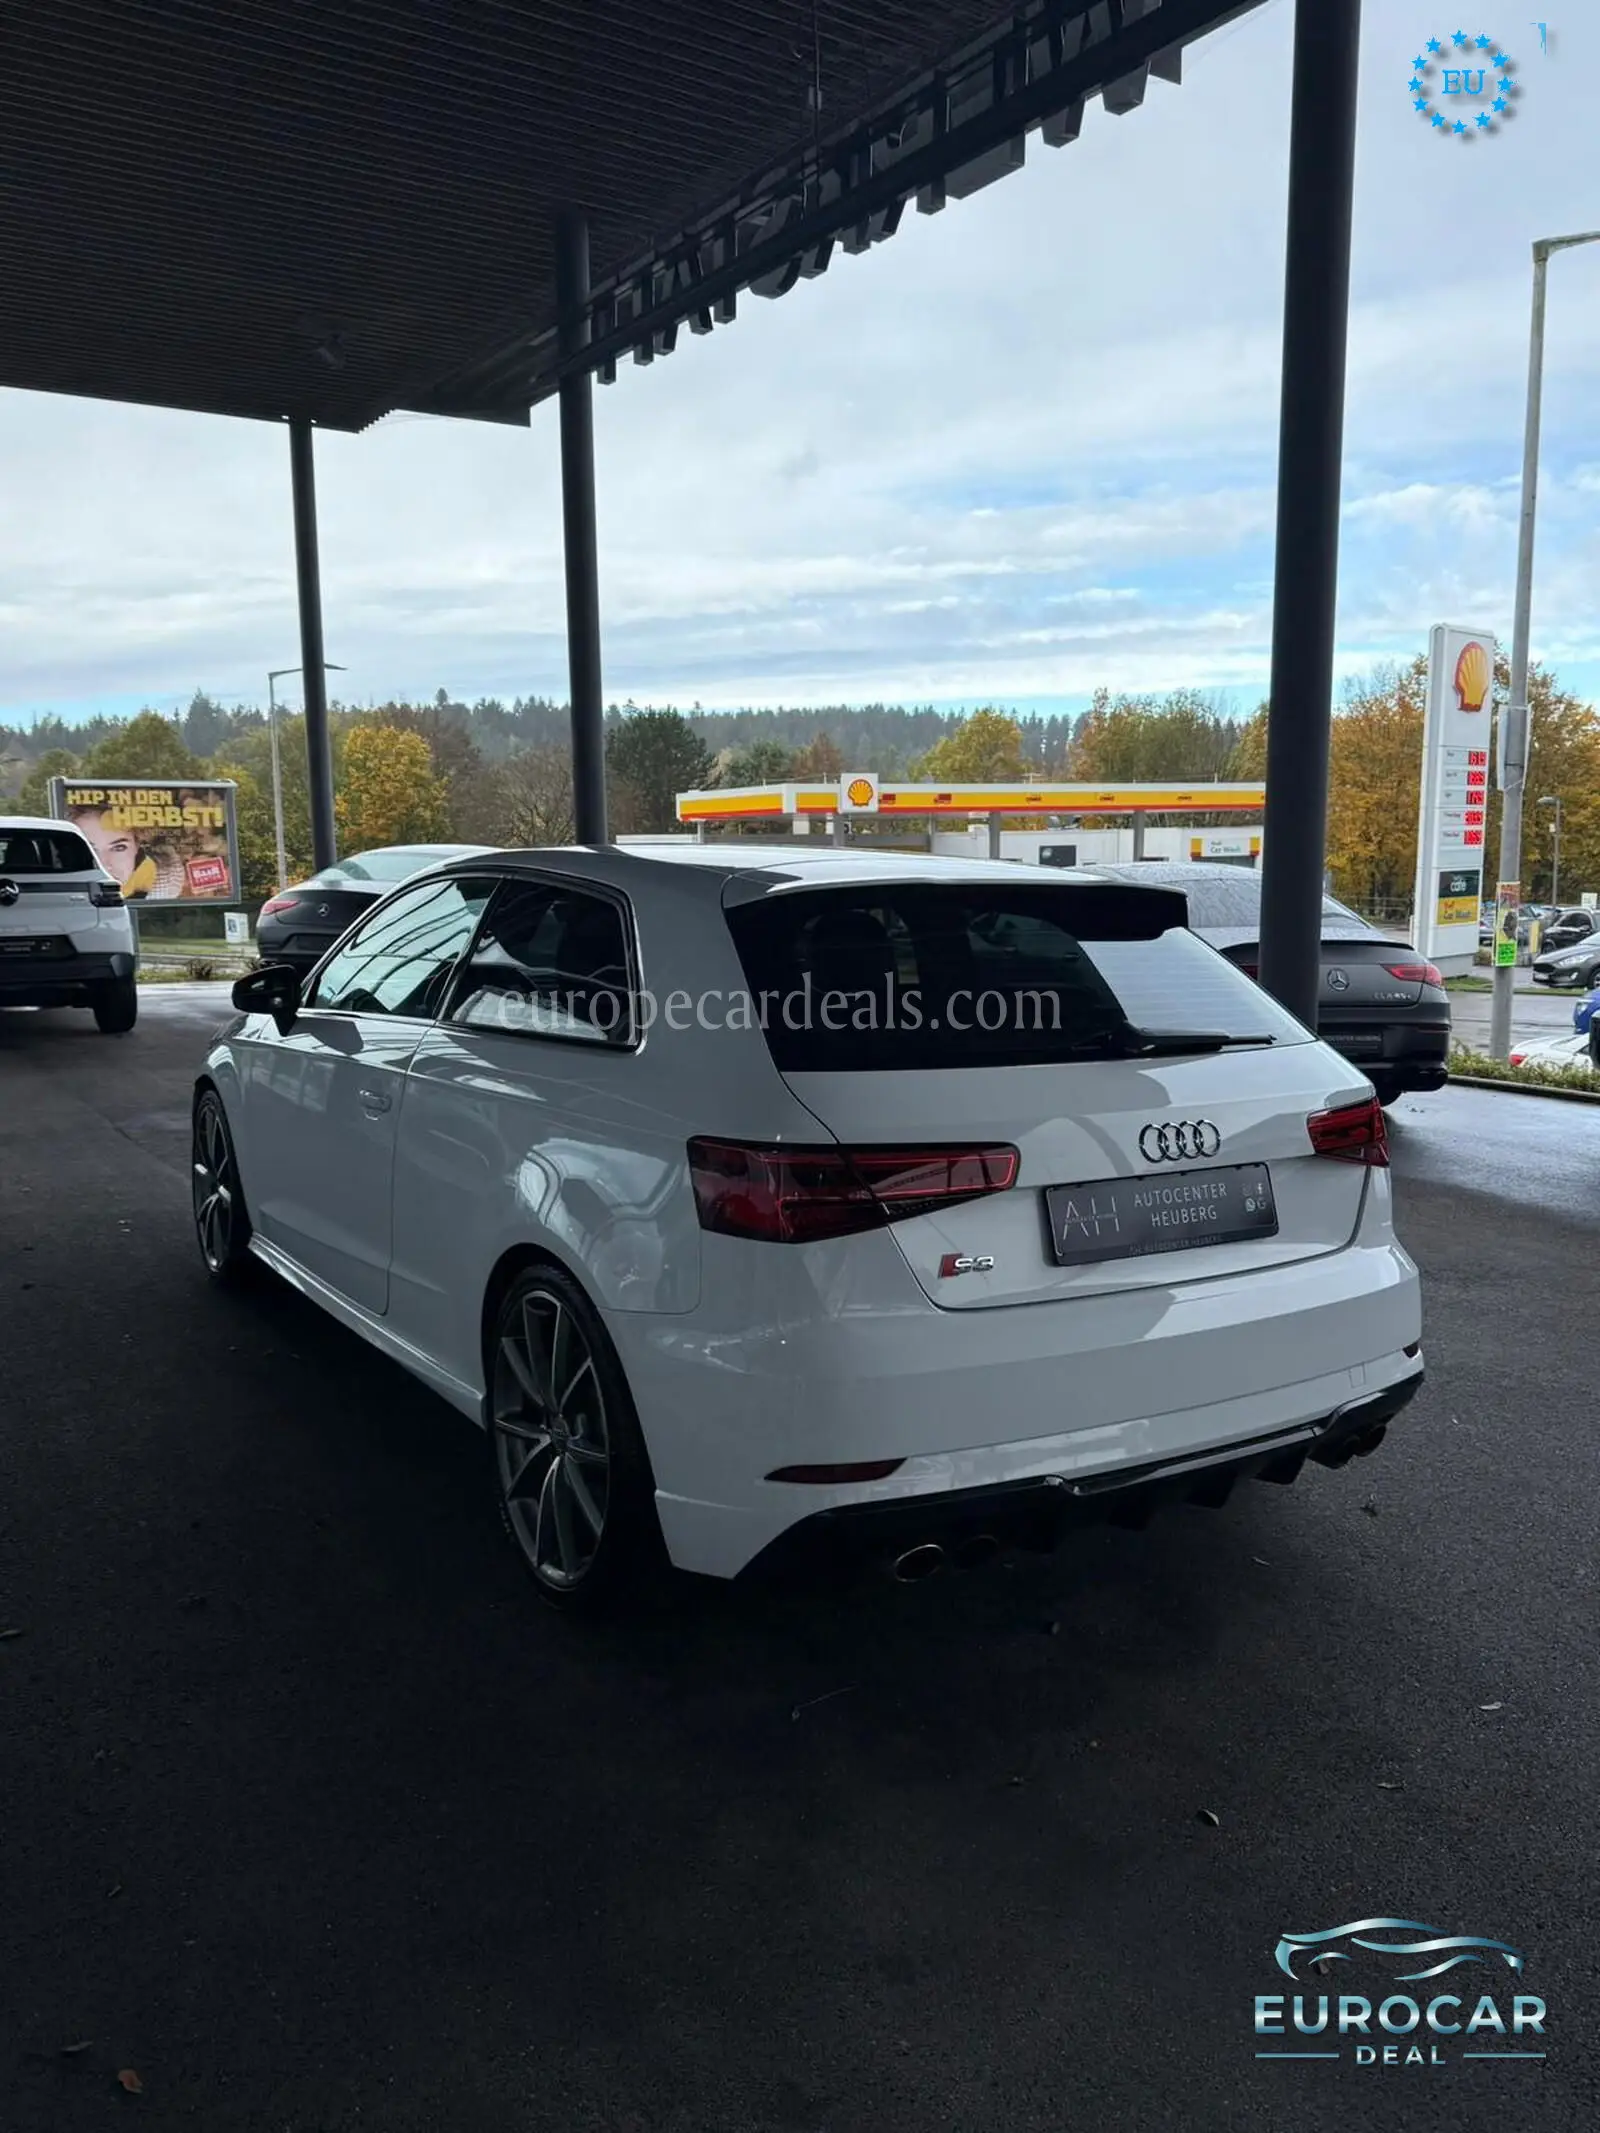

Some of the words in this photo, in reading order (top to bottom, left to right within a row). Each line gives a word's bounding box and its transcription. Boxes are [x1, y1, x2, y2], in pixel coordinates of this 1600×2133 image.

[67, 790, 104, 805] HIP
[107, 789, 132, 805] IN
[112, 806, 224, 828] HERBST!
[1134, 1183, 1228, 1208] AUTOCENTER
[1063, 1196, 1120, 1240] AH
[1151, 1204, 1218, 1228] HEUBERG
[954, 1256, 995, 1273] S3
